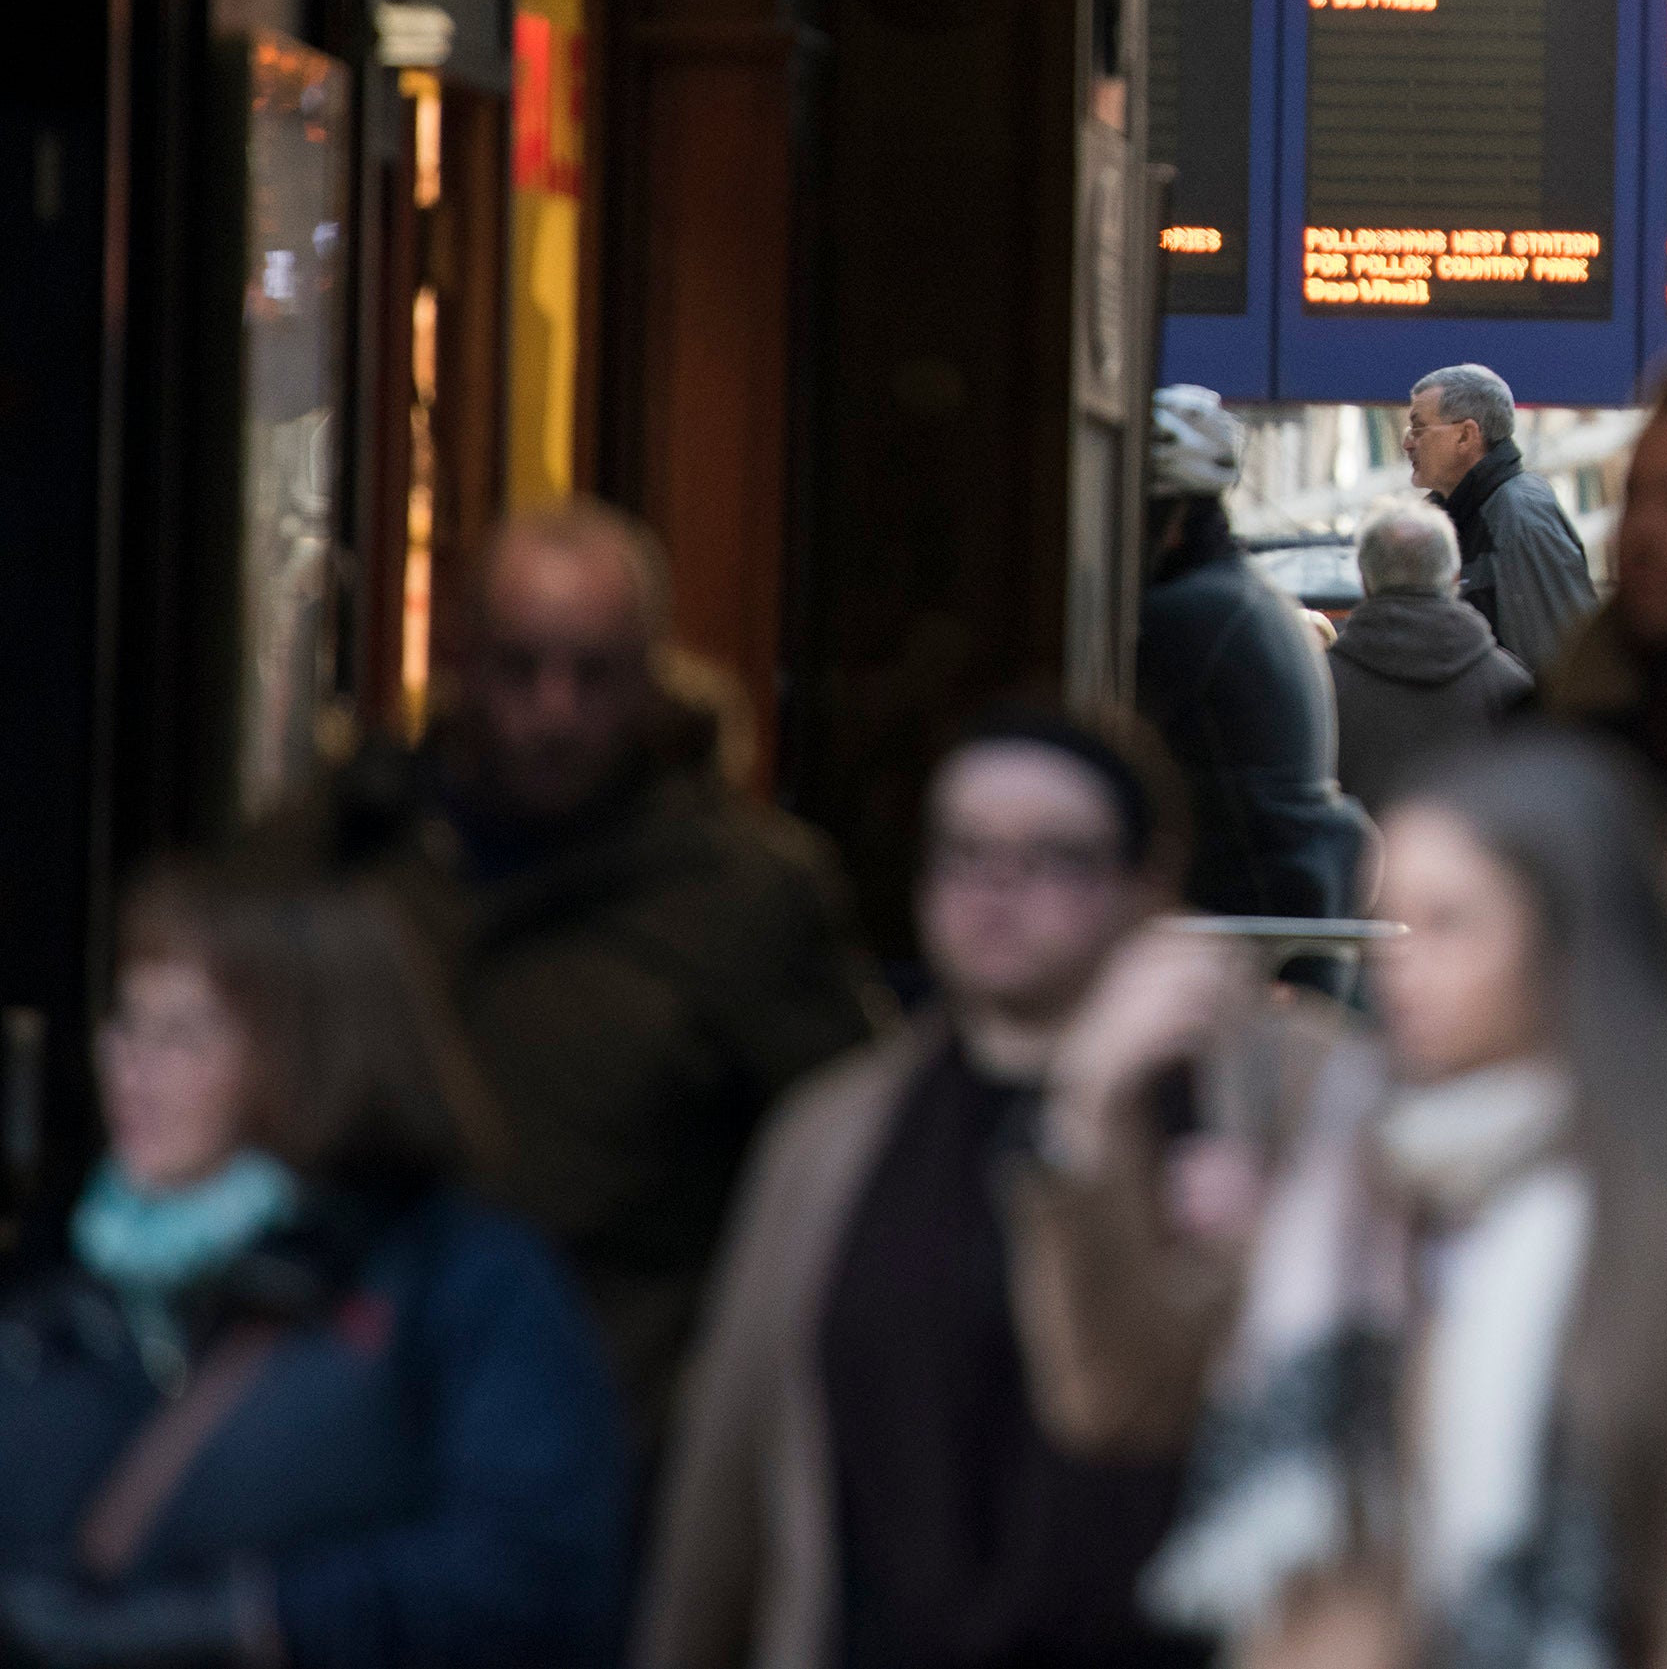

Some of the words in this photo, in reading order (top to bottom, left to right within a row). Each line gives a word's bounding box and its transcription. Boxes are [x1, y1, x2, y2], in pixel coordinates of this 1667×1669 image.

[1511, 232, 1600, 256] STATION
[1305, 253, 1348, 276] FOR
[1437, 255, 1529, 281] COUNTRY
